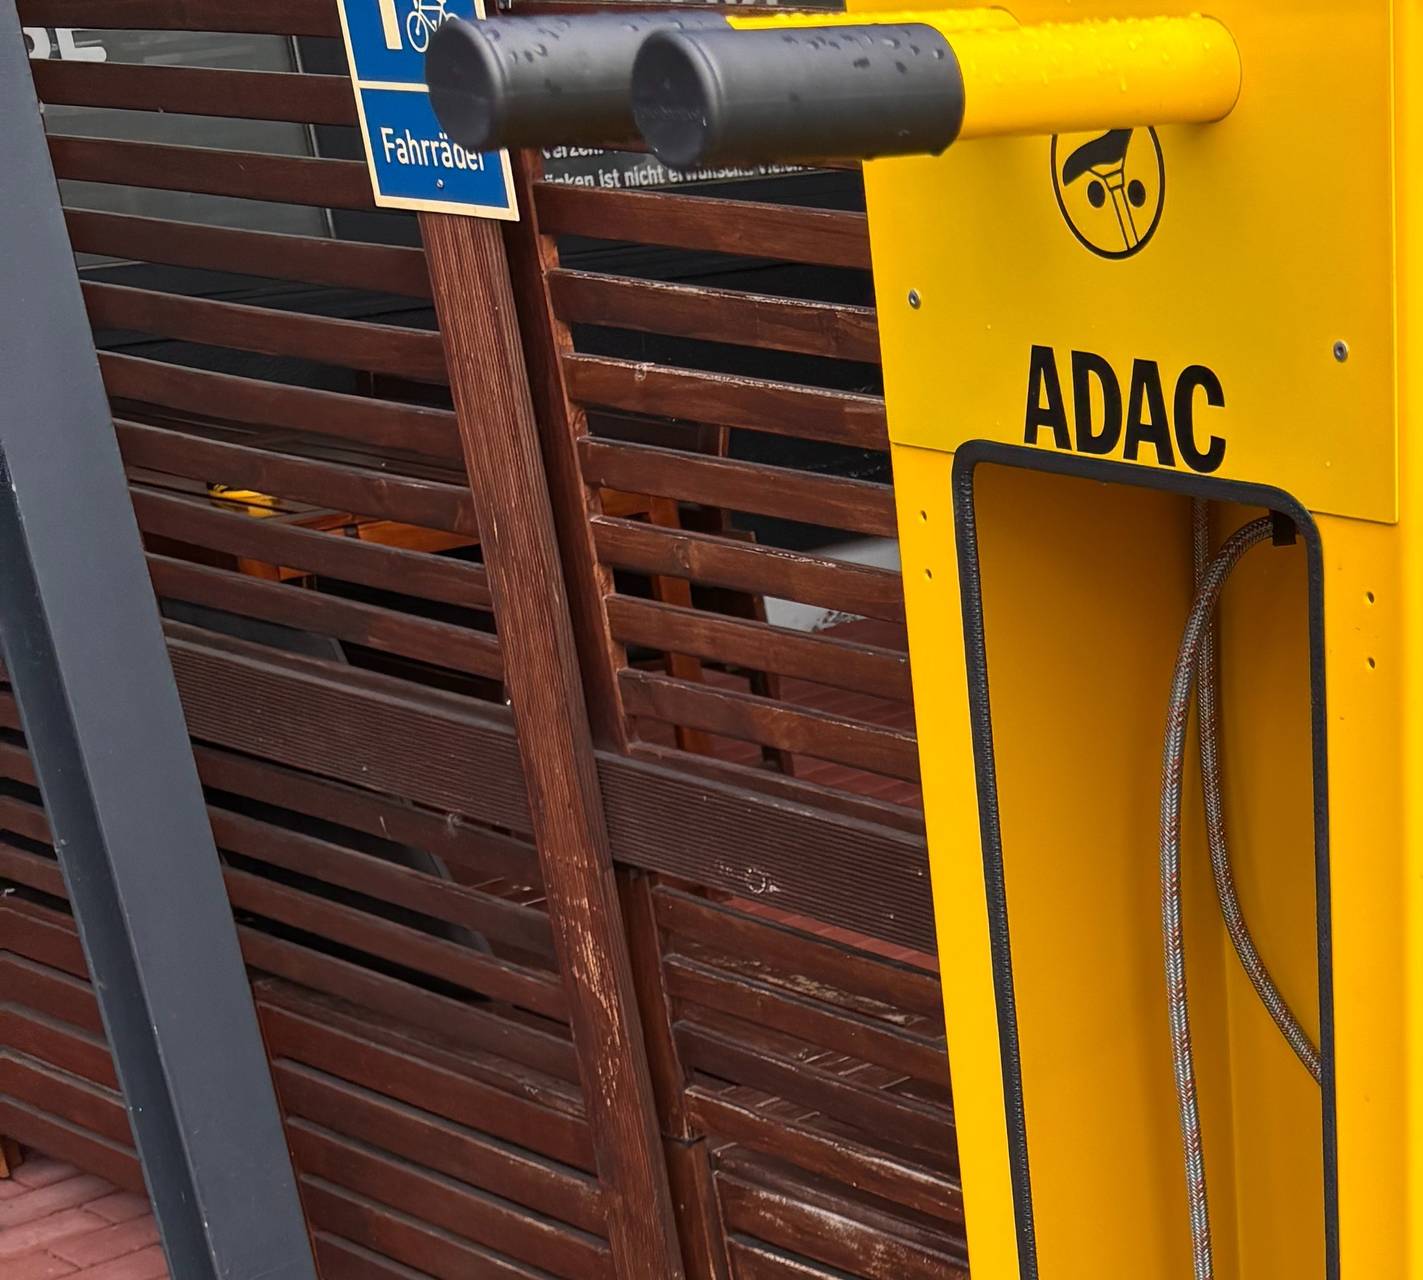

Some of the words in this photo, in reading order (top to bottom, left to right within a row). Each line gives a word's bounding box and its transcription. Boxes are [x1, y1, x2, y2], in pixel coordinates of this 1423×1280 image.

[598, 168, 621, 188] ist
[624, 165, 666, 187] nicht
[1024, 344, 1227, 474] ADAC
